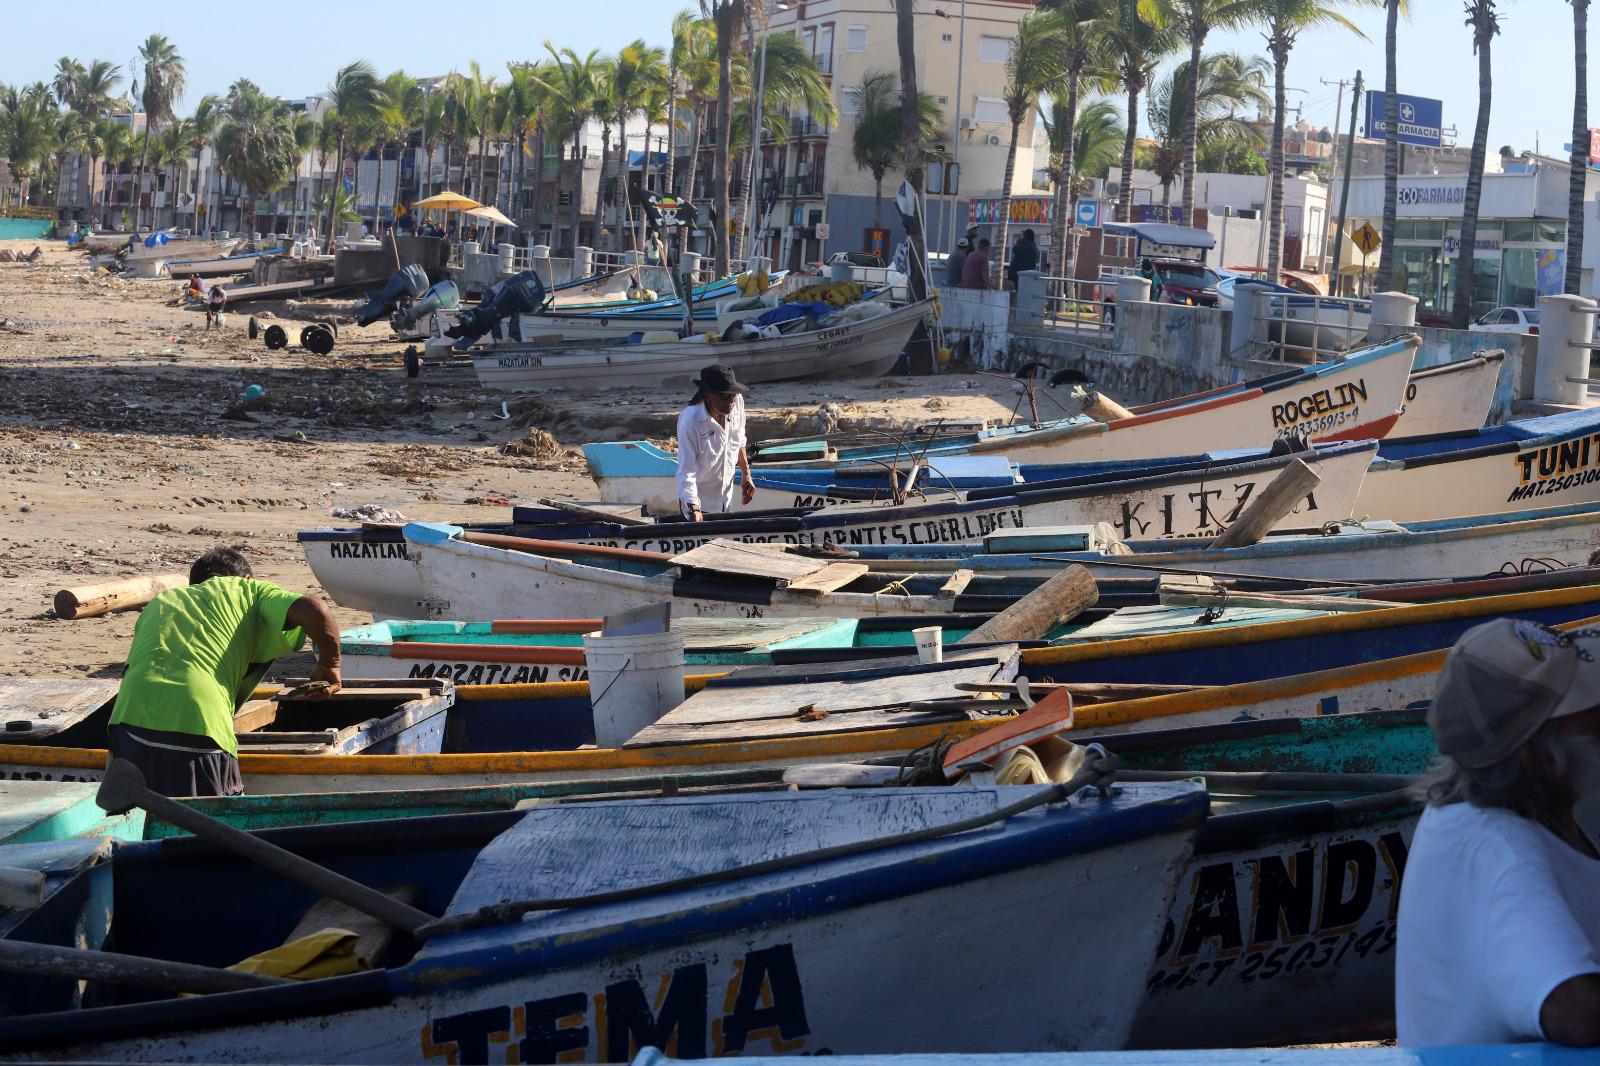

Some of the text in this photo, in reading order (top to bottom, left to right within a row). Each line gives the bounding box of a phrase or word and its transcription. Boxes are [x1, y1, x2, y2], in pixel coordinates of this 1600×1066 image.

[1375, 121, 1439, 138] ECARMACIA
[1398, 187, 1465, 205] ECOFARMACI
[1272, 378, 1368, 428] ROGELIN
[330, 542, 408, 559] MAZATLAN
[409, 662, 549, 685] MAZATLAN
[428, 943, 811, 1066] TEMA
